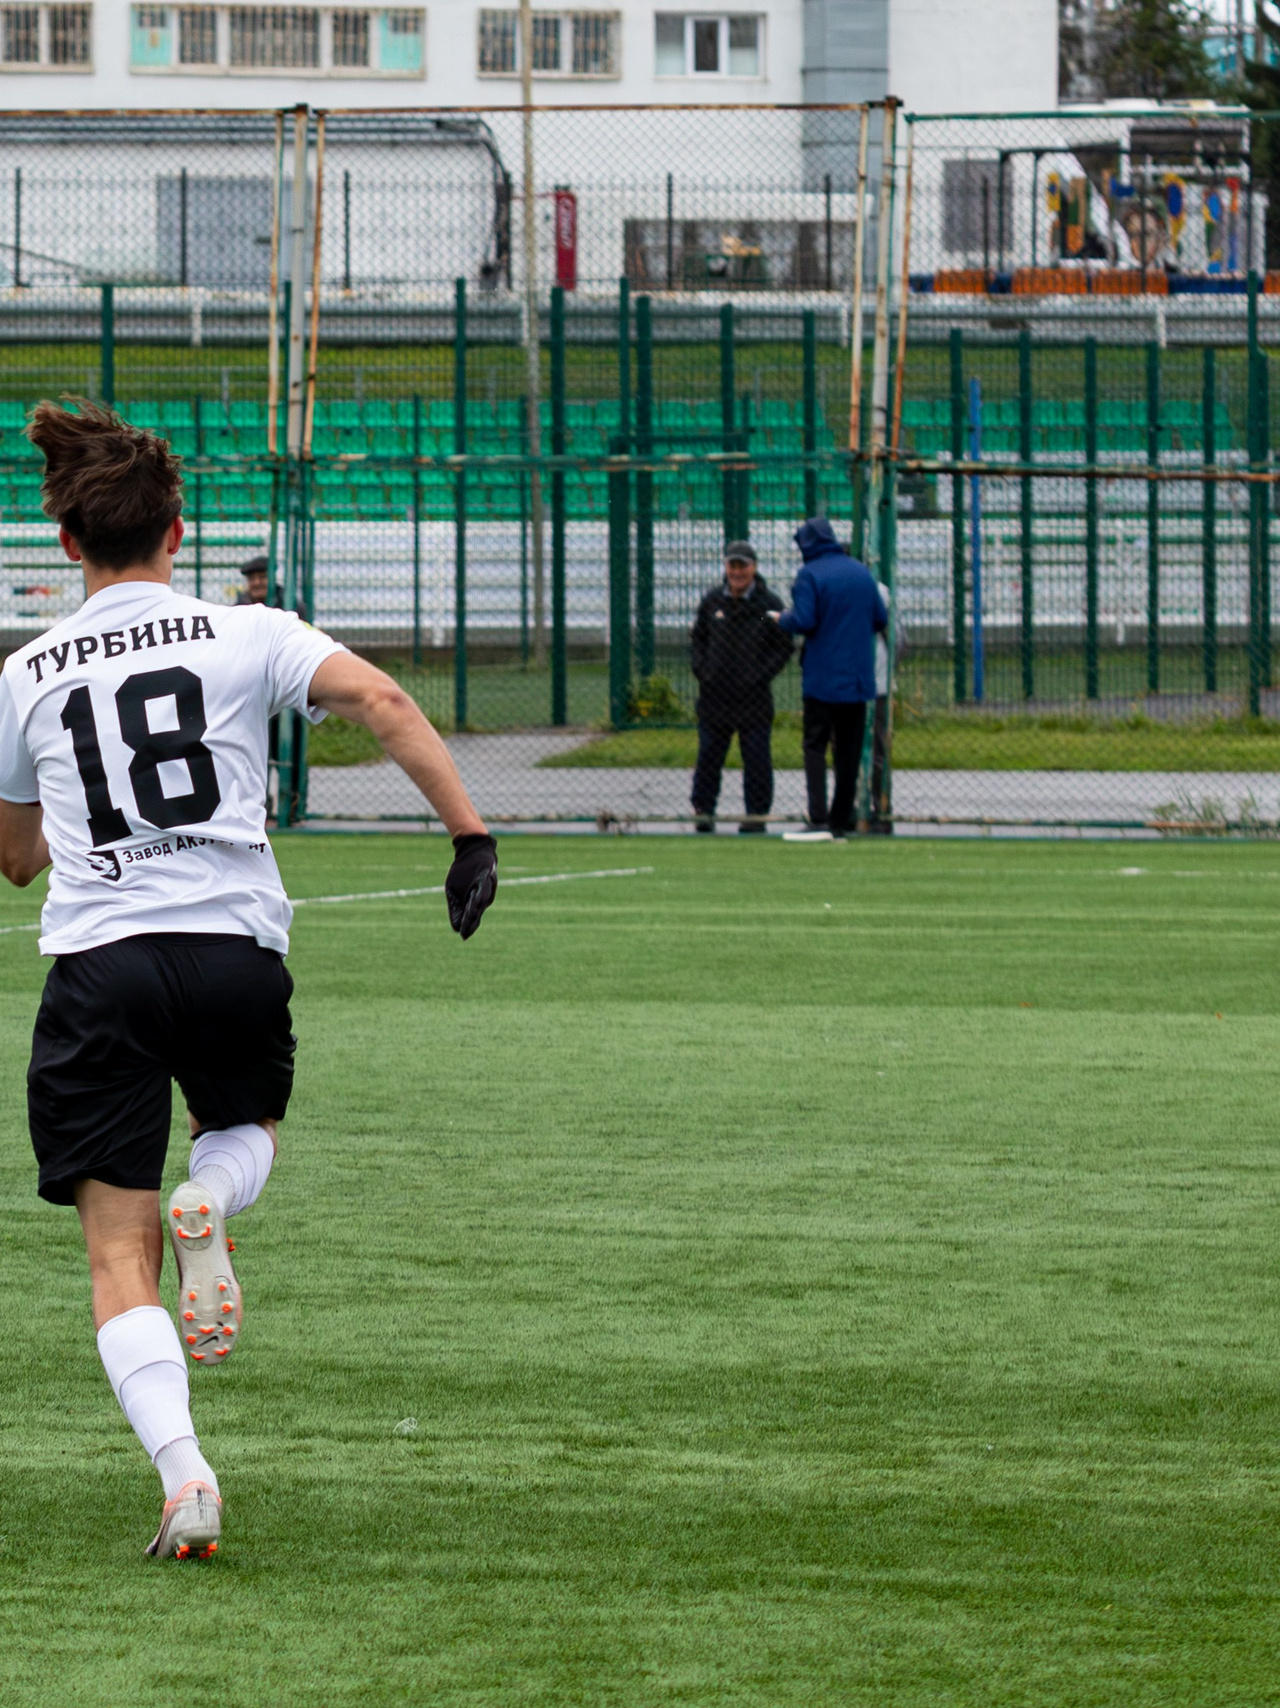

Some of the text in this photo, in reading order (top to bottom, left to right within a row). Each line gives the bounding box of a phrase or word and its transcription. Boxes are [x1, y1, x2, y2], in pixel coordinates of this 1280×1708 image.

[26, 615, 216, 684] ТУРБИНА
[60, 665, 221, 849] 18
[123, 842, 173, 863] Завод
